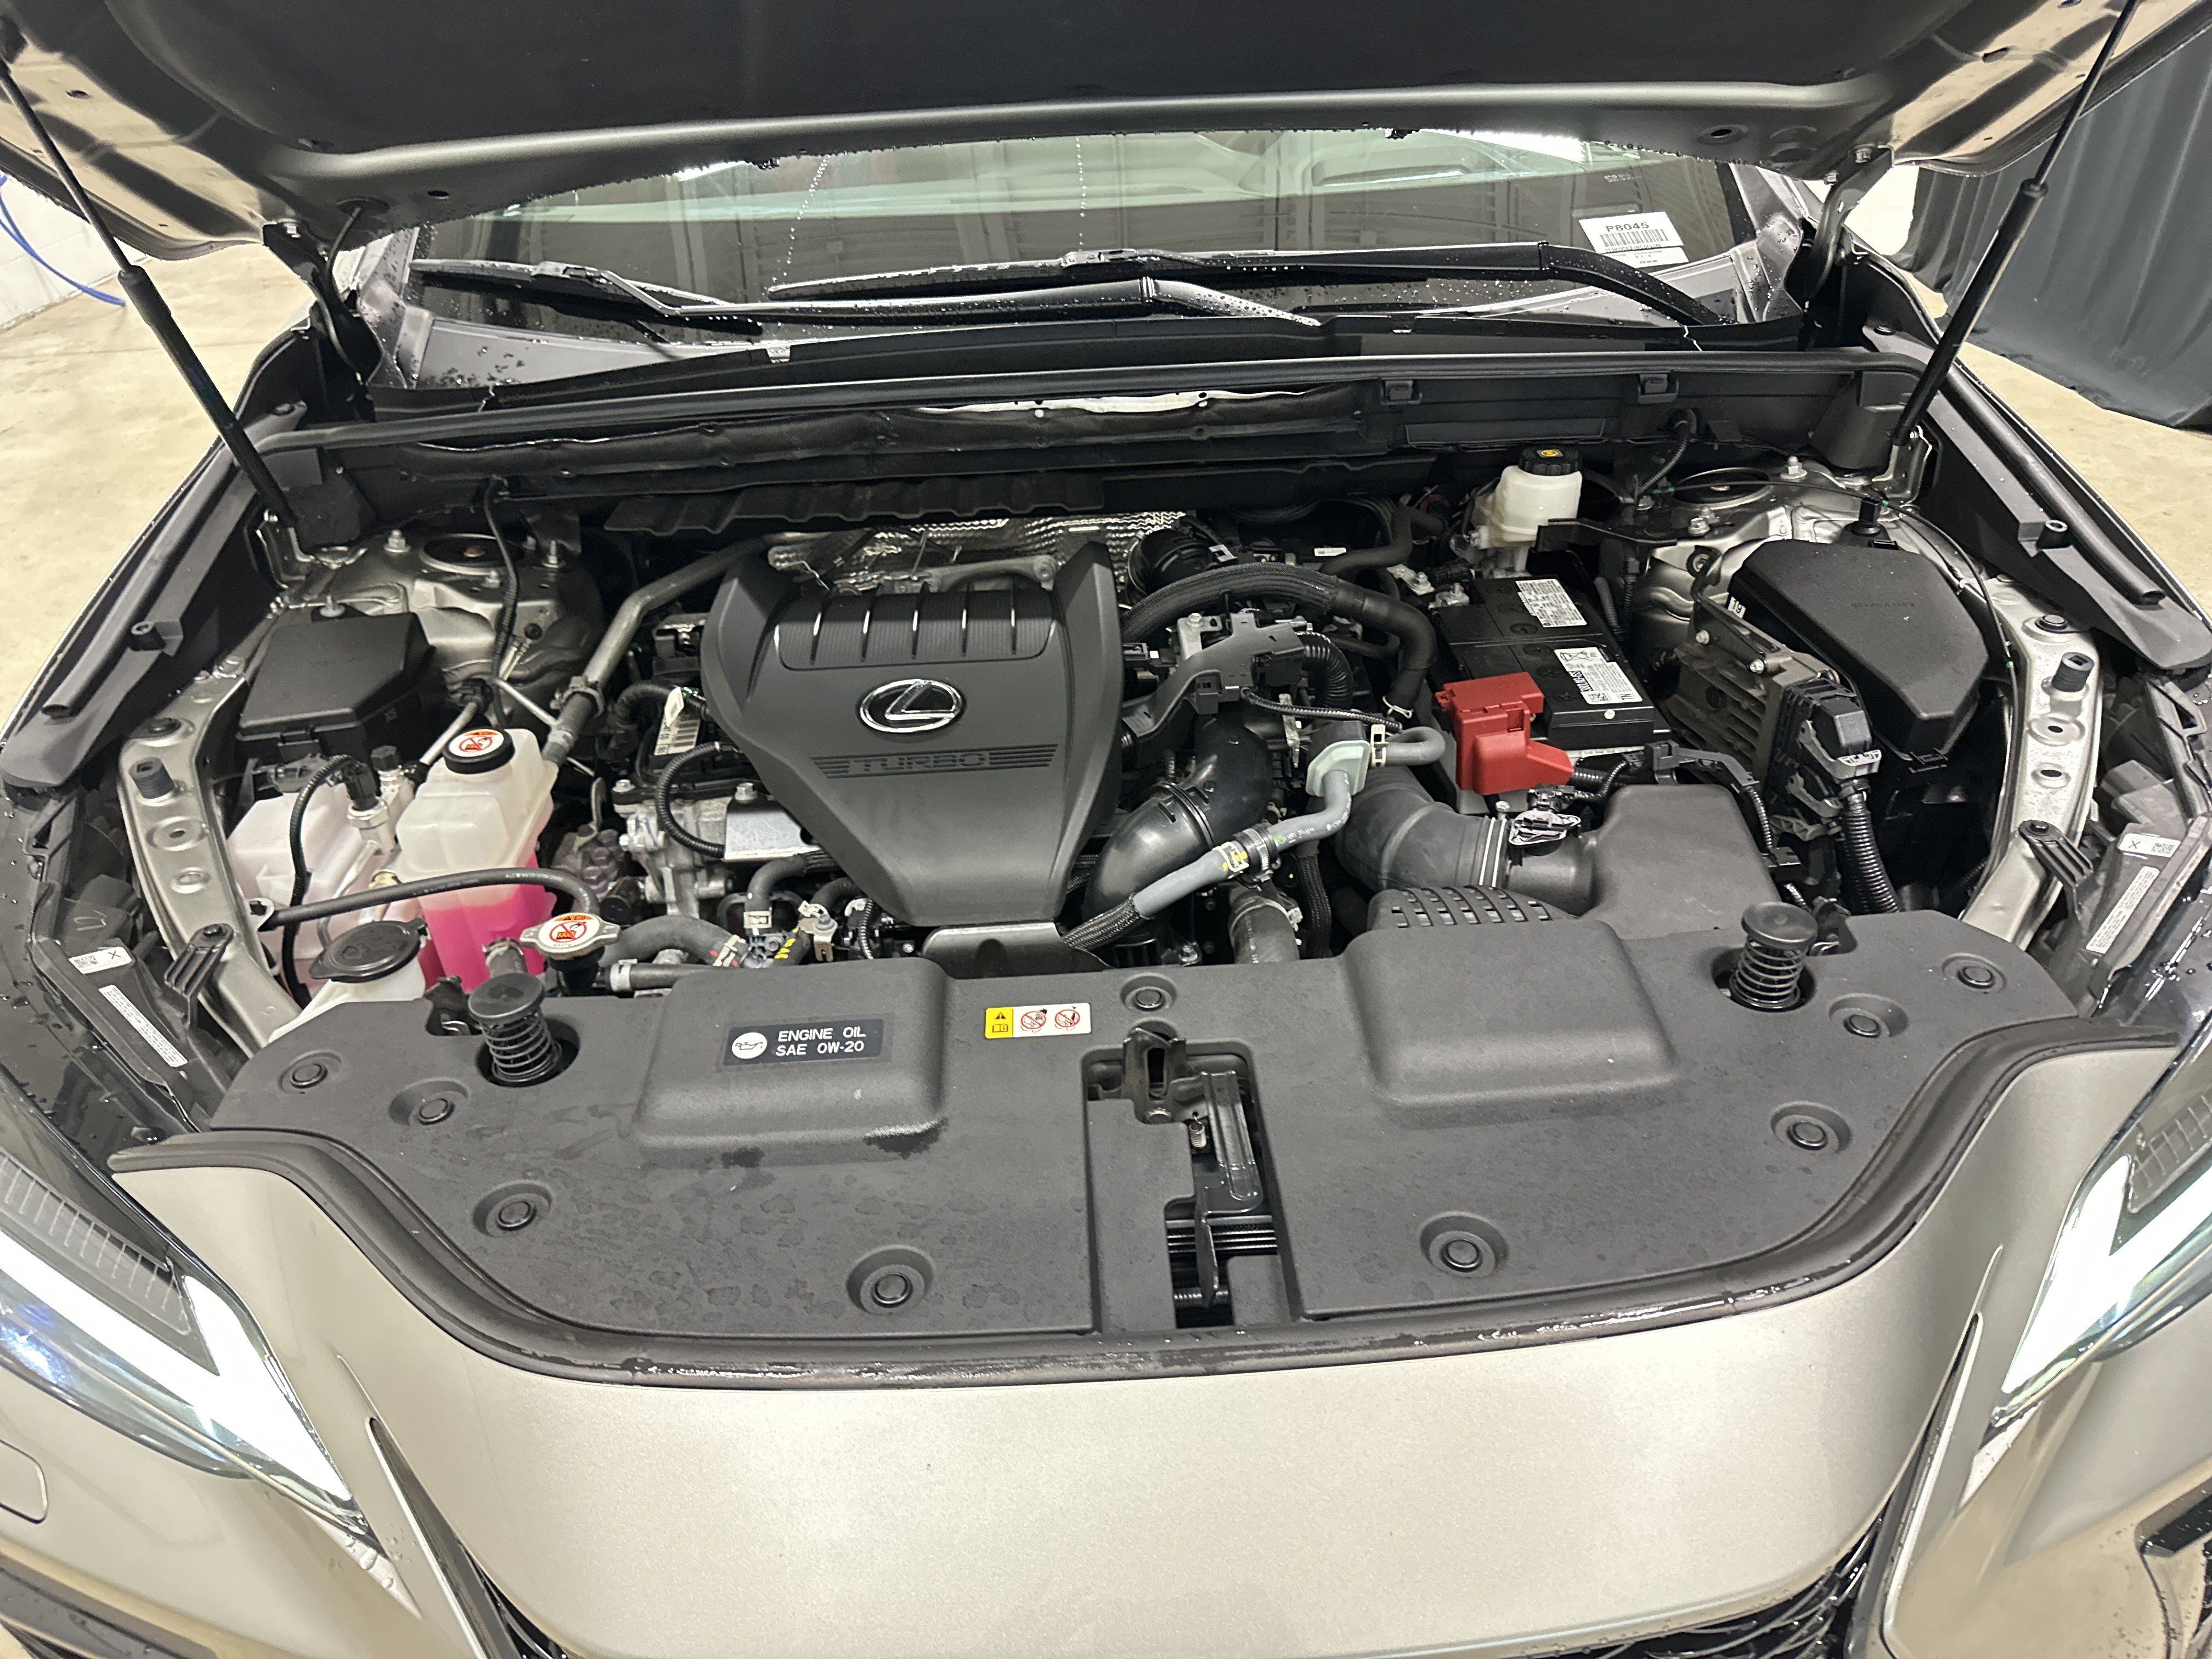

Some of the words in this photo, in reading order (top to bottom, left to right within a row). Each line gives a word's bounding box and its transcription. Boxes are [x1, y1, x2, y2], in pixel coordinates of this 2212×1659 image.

[1605, 222, 1650, 232] P8045
[854, 753, 985, 772] TURBO
[777, 1028, 833, 1042] ENGINE
[843, 1026, 866, 1039] OIL
[776, 1043, 808, 1057] SAE
[817, 1040, 865, 1054] 0W-20
